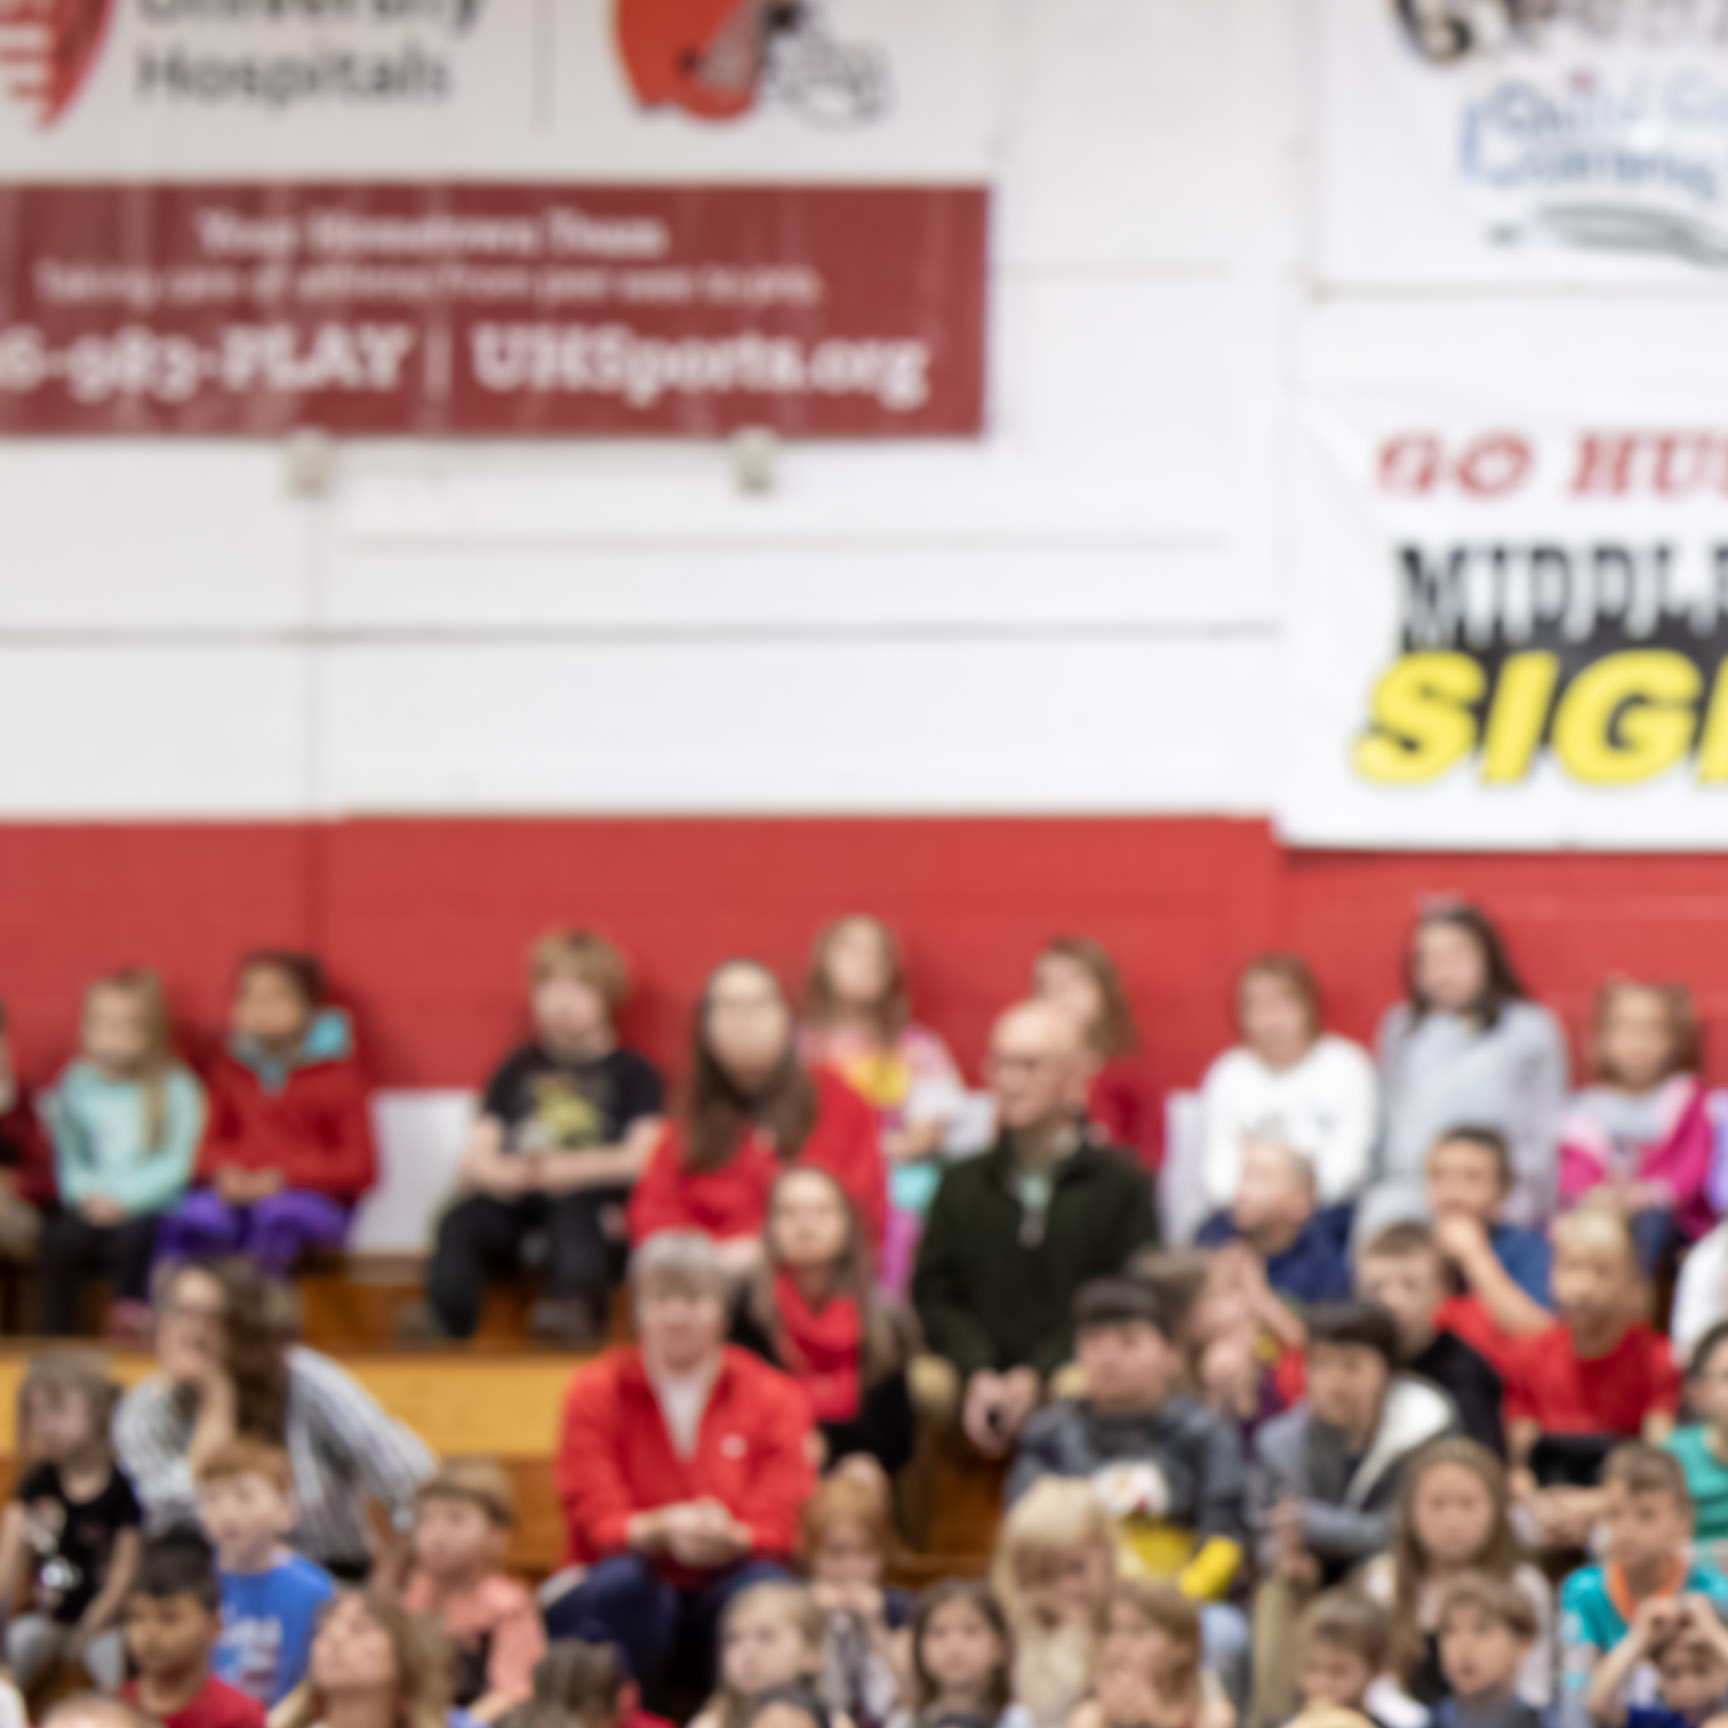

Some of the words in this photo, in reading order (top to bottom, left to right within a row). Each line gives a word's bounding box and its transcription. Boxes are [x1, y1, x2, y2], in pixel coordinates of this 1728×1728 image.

[139, 46, 453, 110] Hospitals
[474, 326, 928, 403] UHSports.org
[1375, 430, 1534, 500] GO
